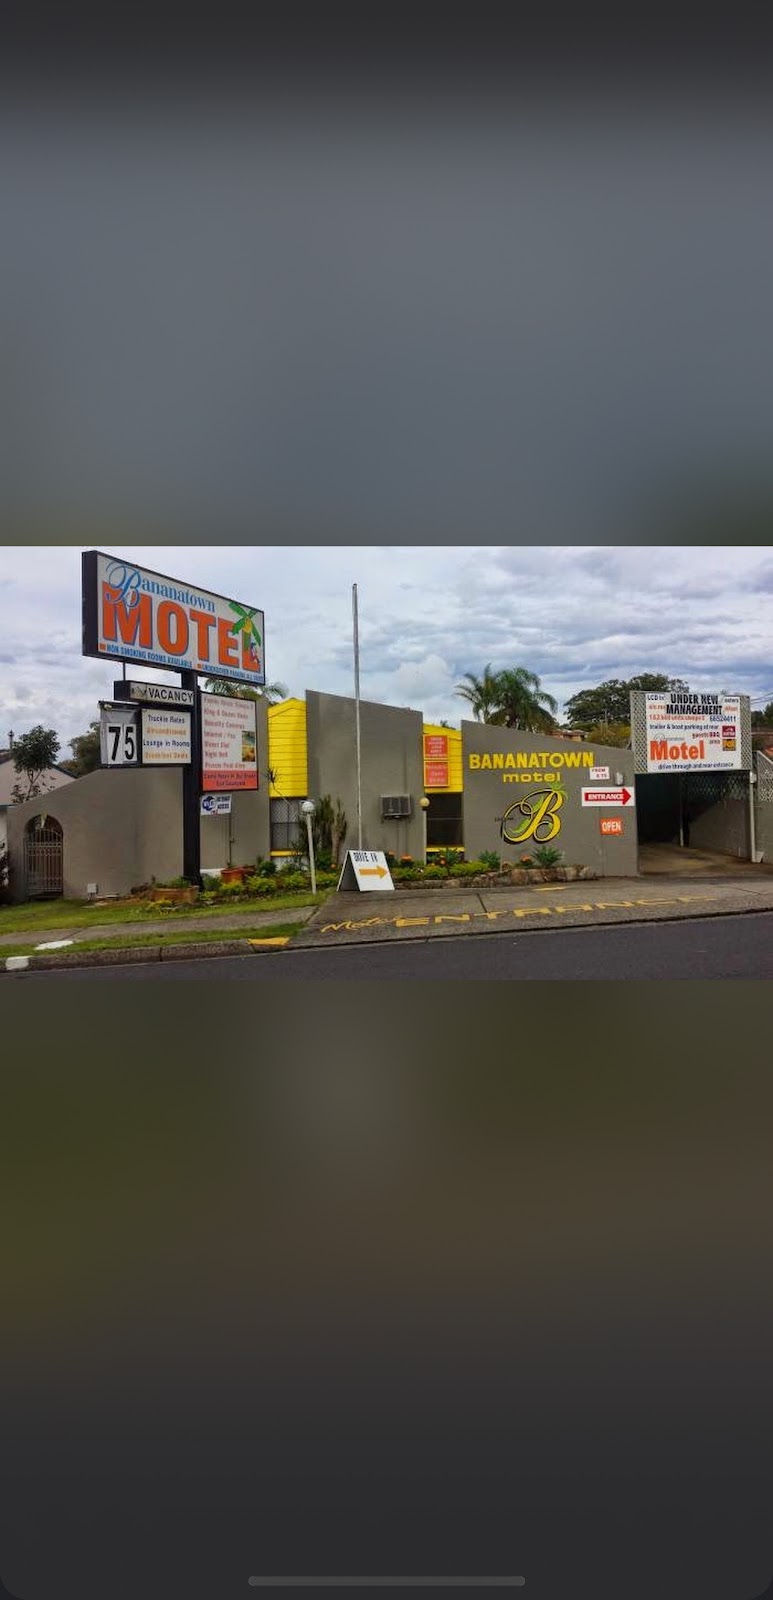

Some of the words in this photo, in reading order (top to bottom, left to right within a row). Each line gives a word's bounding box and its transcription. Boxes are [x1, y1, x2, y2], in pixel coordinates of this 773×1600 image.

[106, 561, 215, 613] Bananatown
[102, 581, 261, 673] MOTEL
[121, 646, 146, 659] SMOKING
[148, 652, 166, 663] ROOMS
[168, 655, 193, 668] AVAILABLE
[148, 687, 193, 702] VACANCY
[670, 694, 698, 704] UNDER
[701, 694, 718, 704] NEW
[666, 704, 722, 715] MANAGEMENT
[148, 714, 168, 723] Truckie
[170, 716, 185, 724] Rates
[108, 726, 135, 762] 75
[144, 739, 163, 748] Lounge
[172, 740, 190, 748] Rooms
[650, 740, 704, 760] Motel
[469, 751, 594, 769] BANANATOWN
[503, 772, 561, 782] motel
[602, 821, 622, 831] OPEN
[353, 852, 369, 862] DRIVE
[394, 895, 719, 928] ENTRANCE
